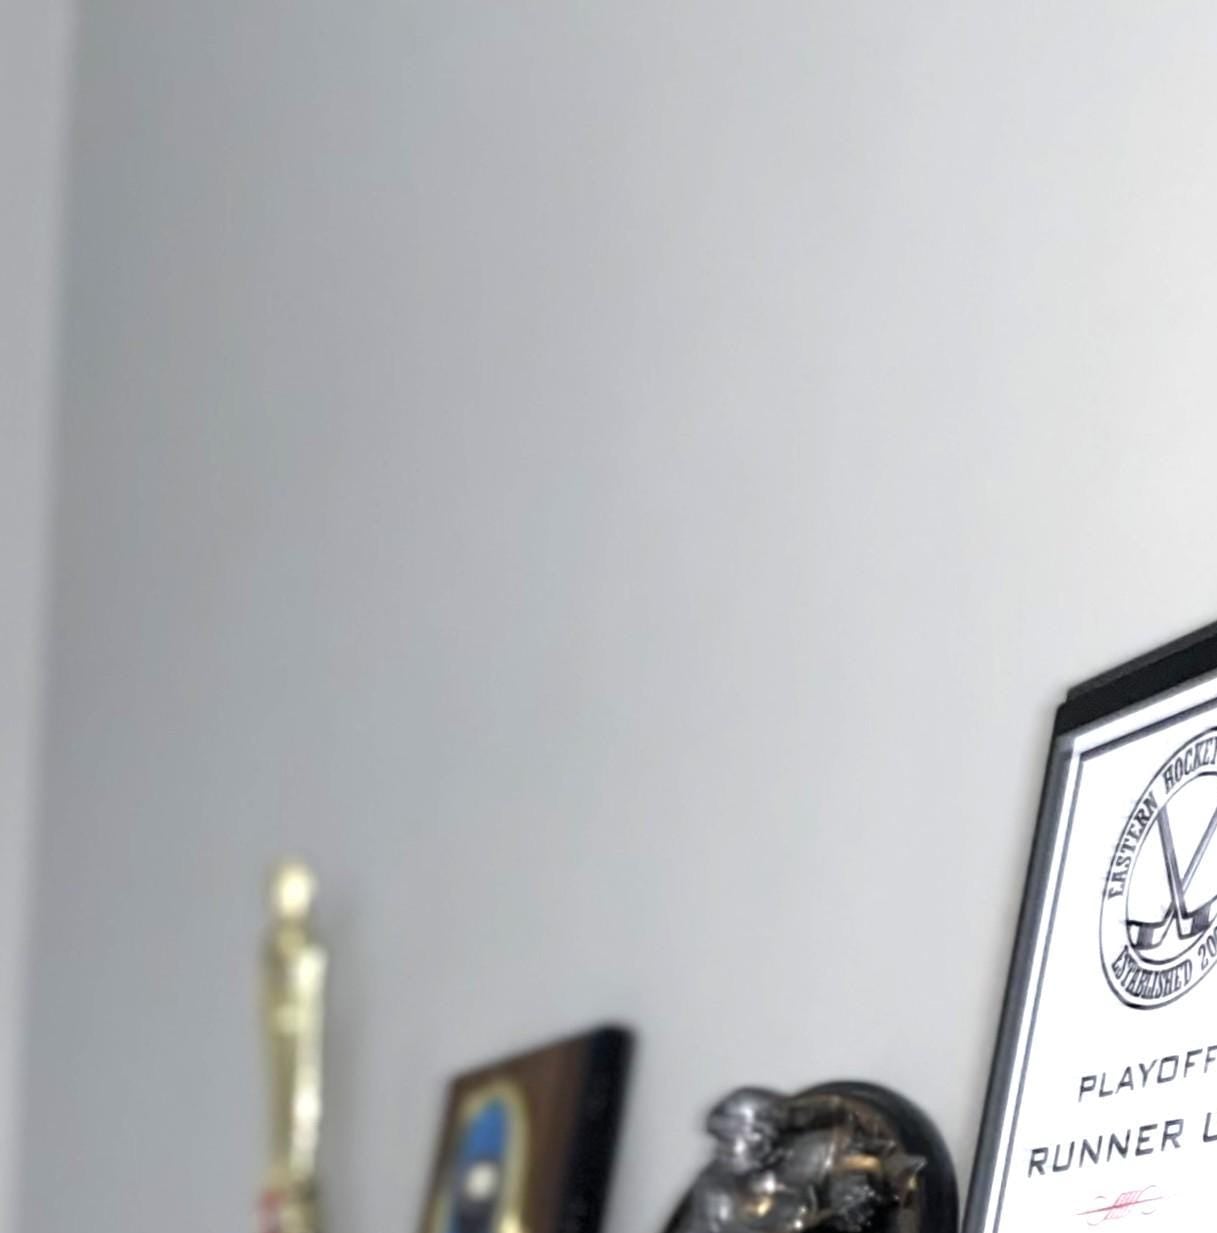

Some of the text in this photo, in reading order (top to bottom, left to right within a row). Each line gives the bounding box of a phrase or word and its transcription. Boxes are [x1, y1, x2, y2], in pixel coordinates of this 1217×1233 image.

[1107, 790, 1159, 900] EASTERN
[1111, 944, 1194, 1001] ESTABLISHED
[1027, 1118, 1185, 1178] RUNNER
